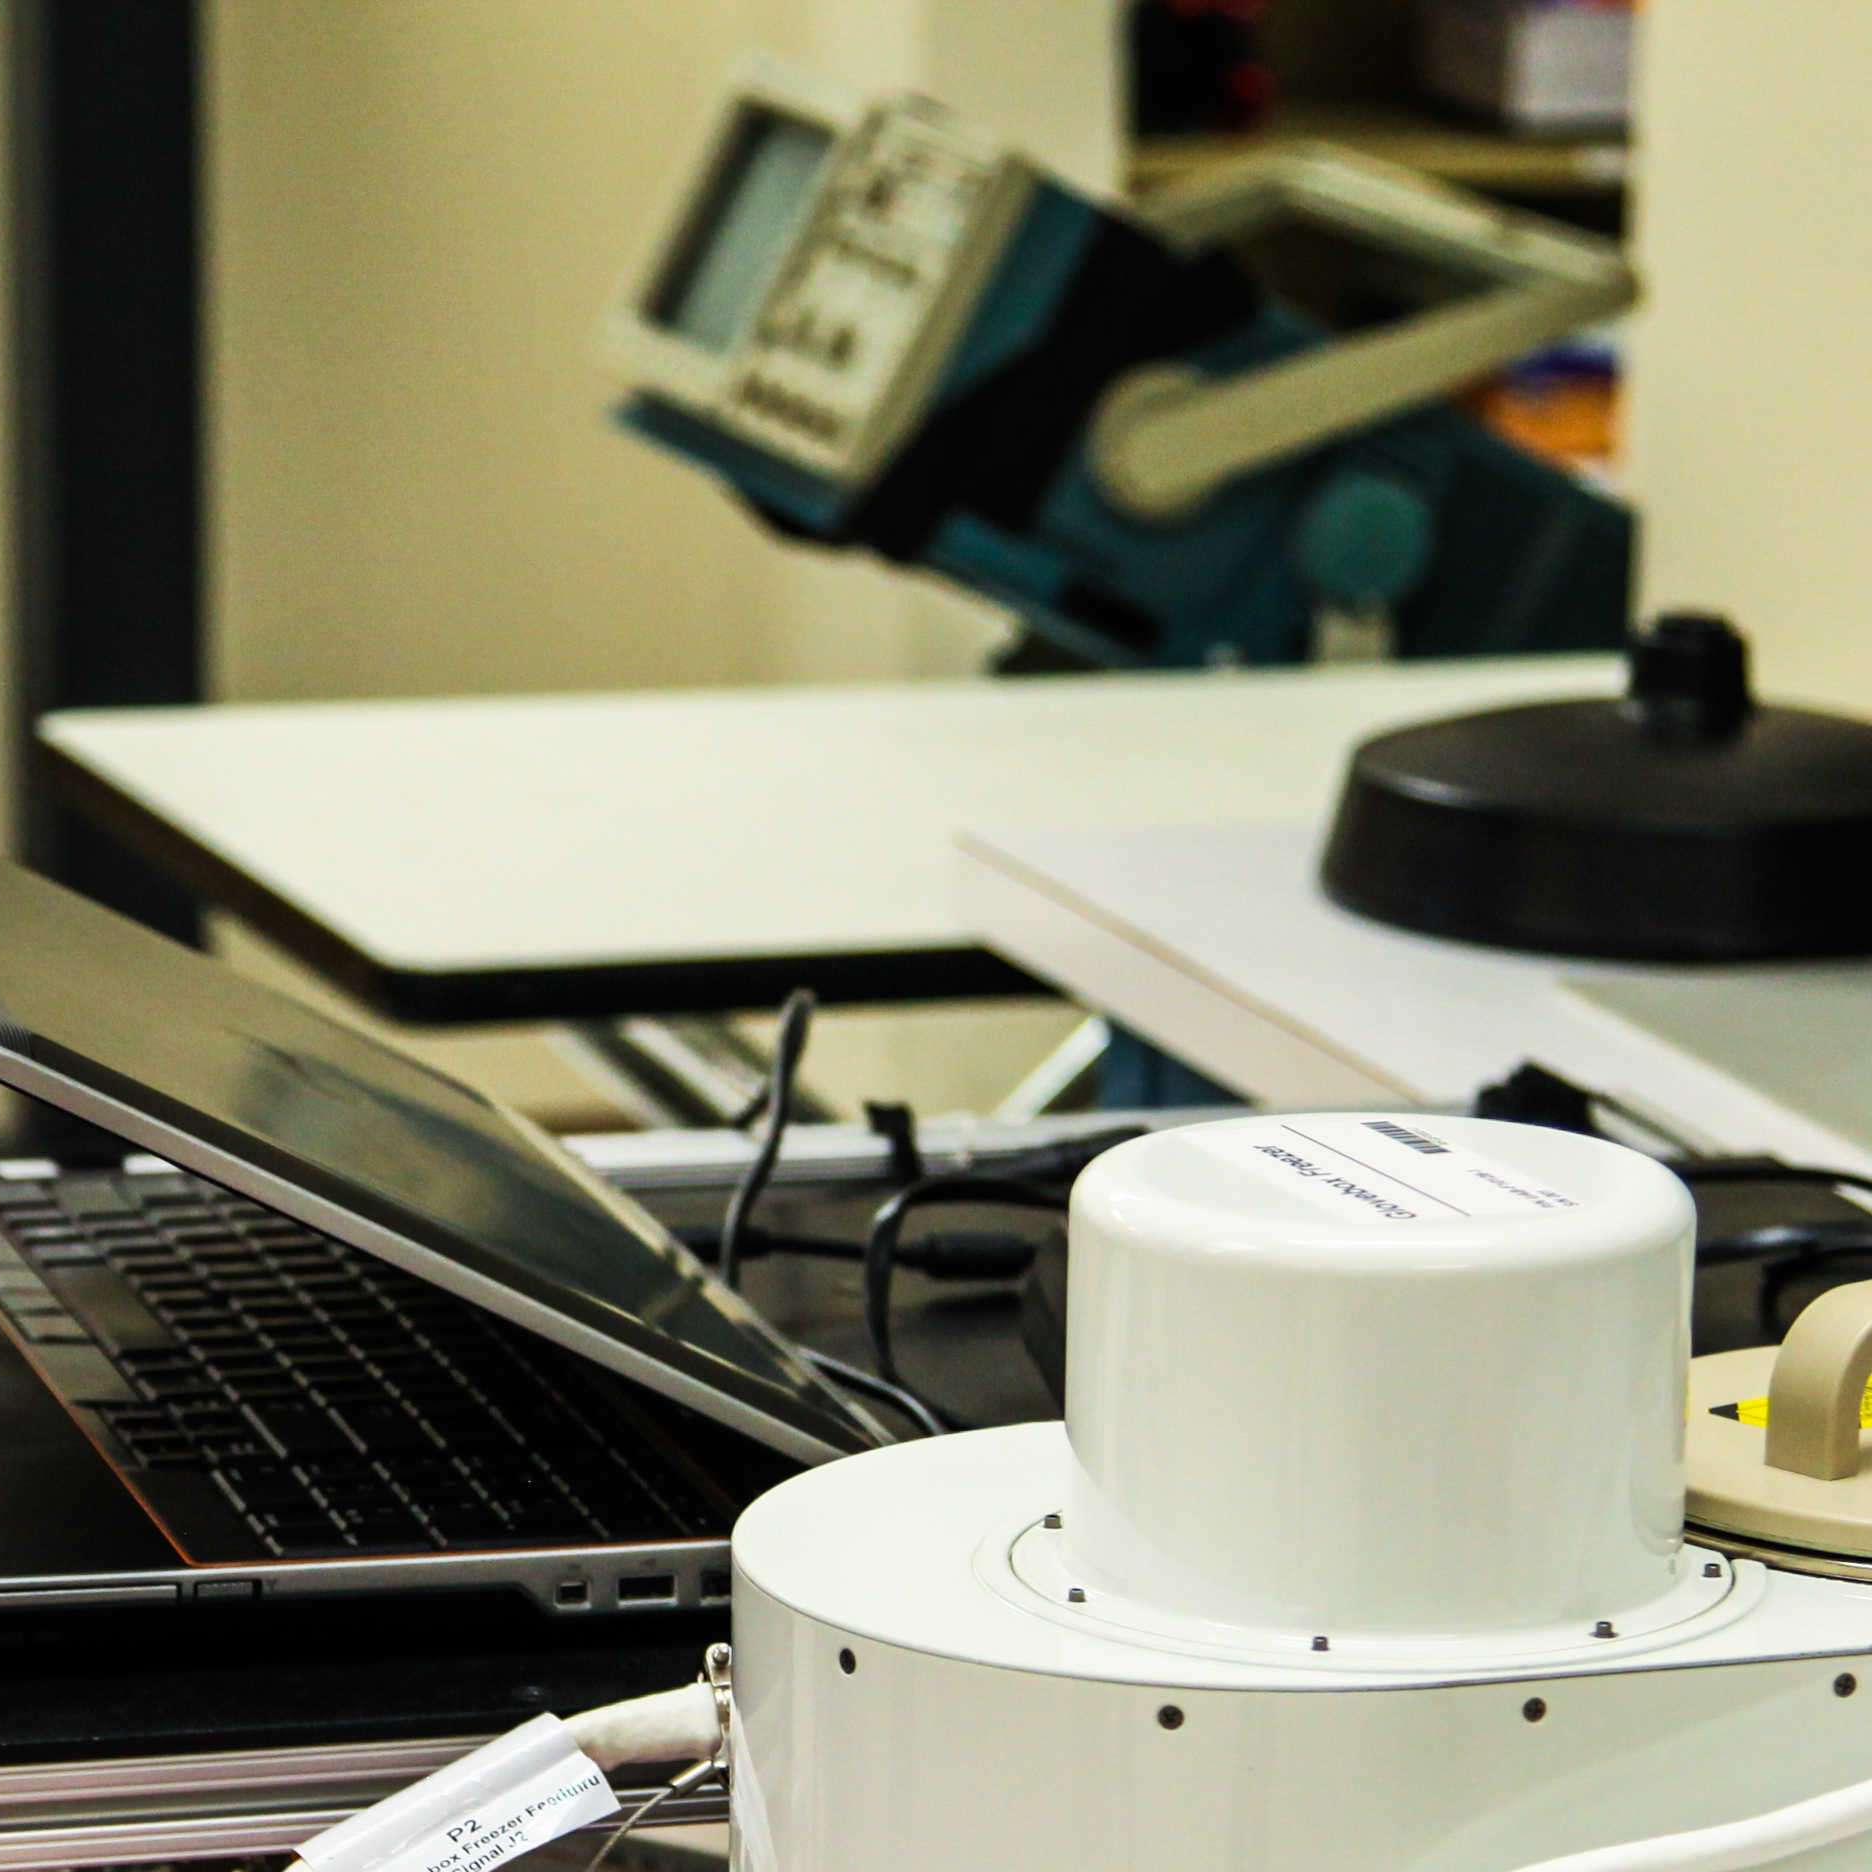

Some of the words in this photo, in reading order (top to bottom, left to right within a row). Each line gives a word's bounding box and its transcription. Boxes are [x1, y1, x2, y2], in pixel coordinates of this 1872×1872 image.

[1253, 1144, 1332, 1178] Freezer
[1323, 1177, 1417, 1220] Glovebox
[446, 1818, 482, 1843] P2
[463, 1815, 523, 1855] Freezer
